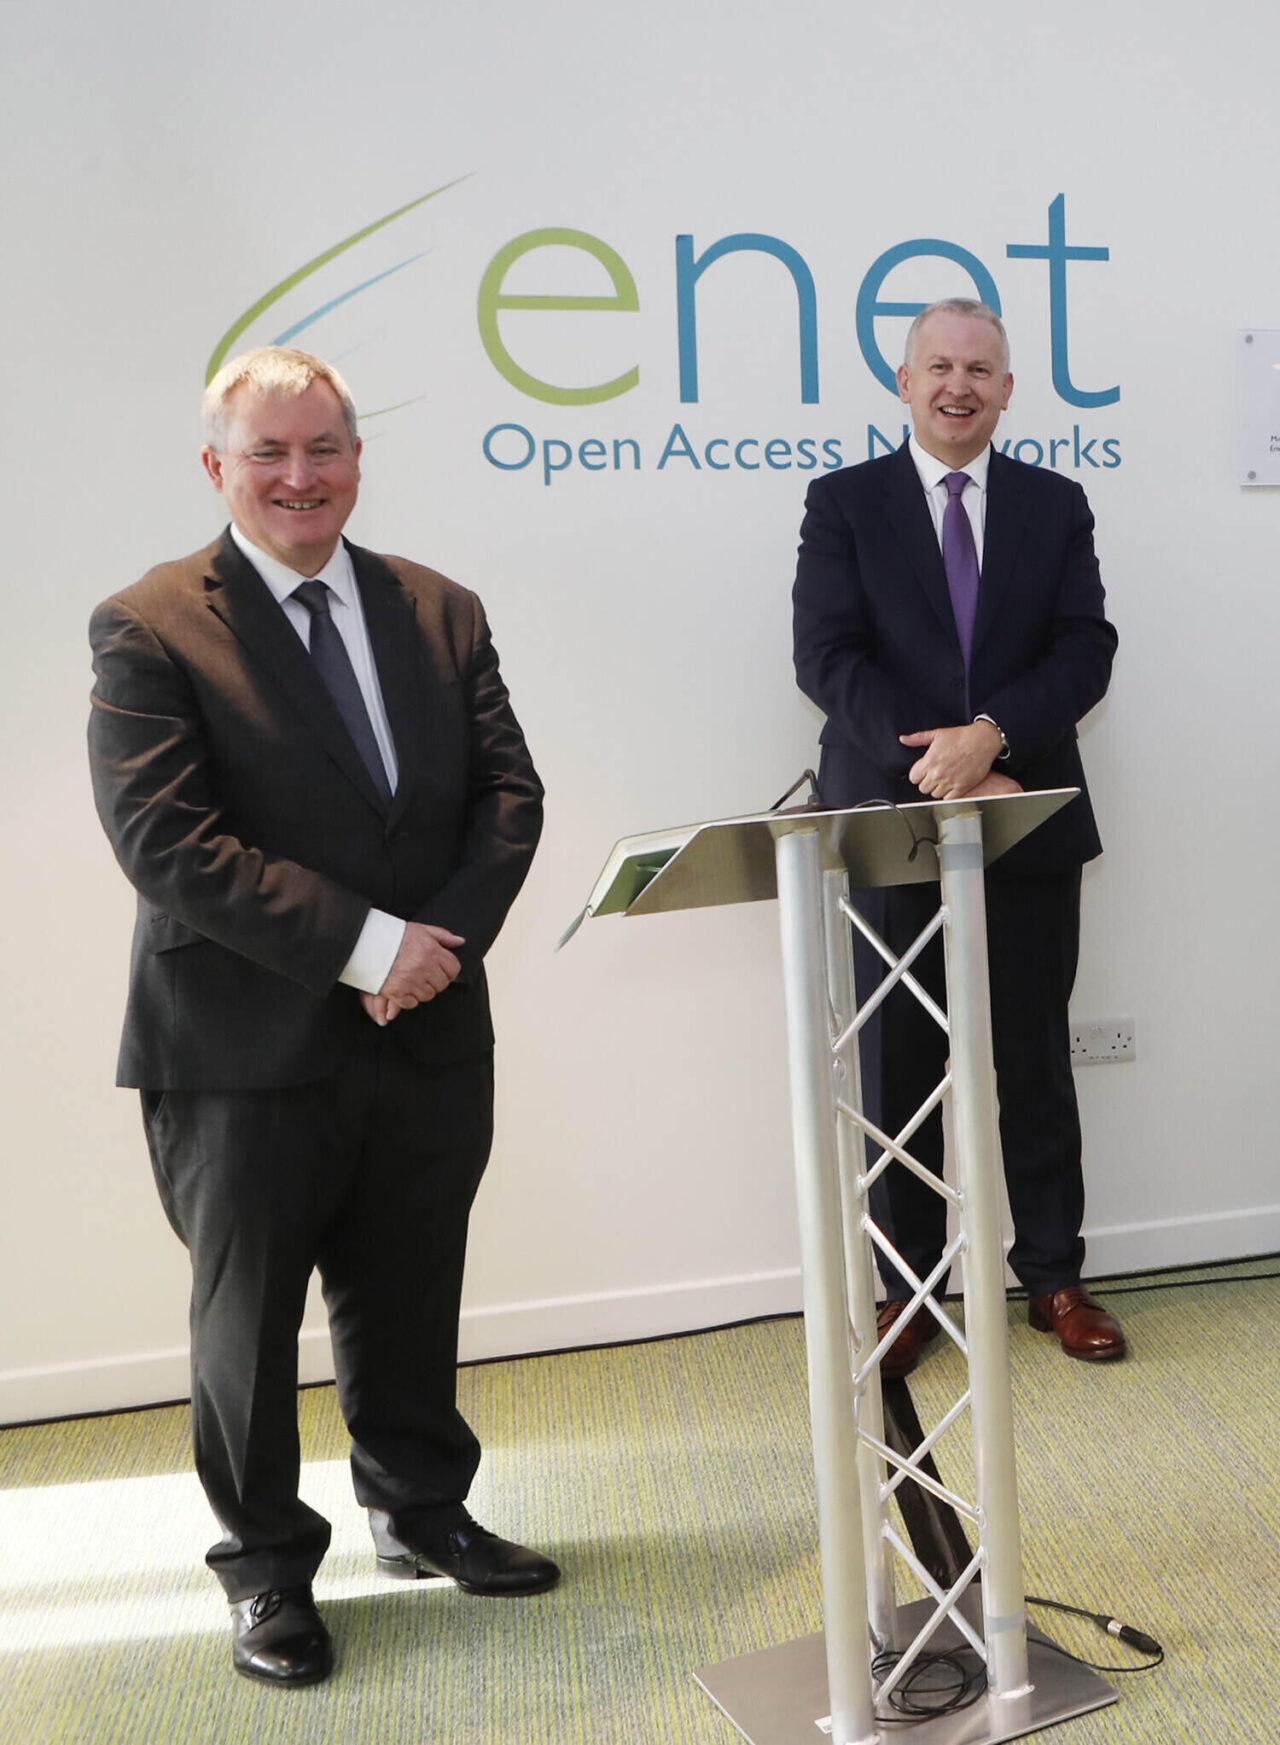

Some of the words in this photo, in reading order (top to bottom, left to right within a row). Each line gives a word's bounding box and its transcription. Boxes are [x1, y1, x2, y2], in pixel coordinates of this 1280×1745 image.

[477, 192, 1121, 409] enet
[482, 423, 642, 486] Open
[656, 423, 844, 470] Access
[867, 424, 1122, 468] Norks
